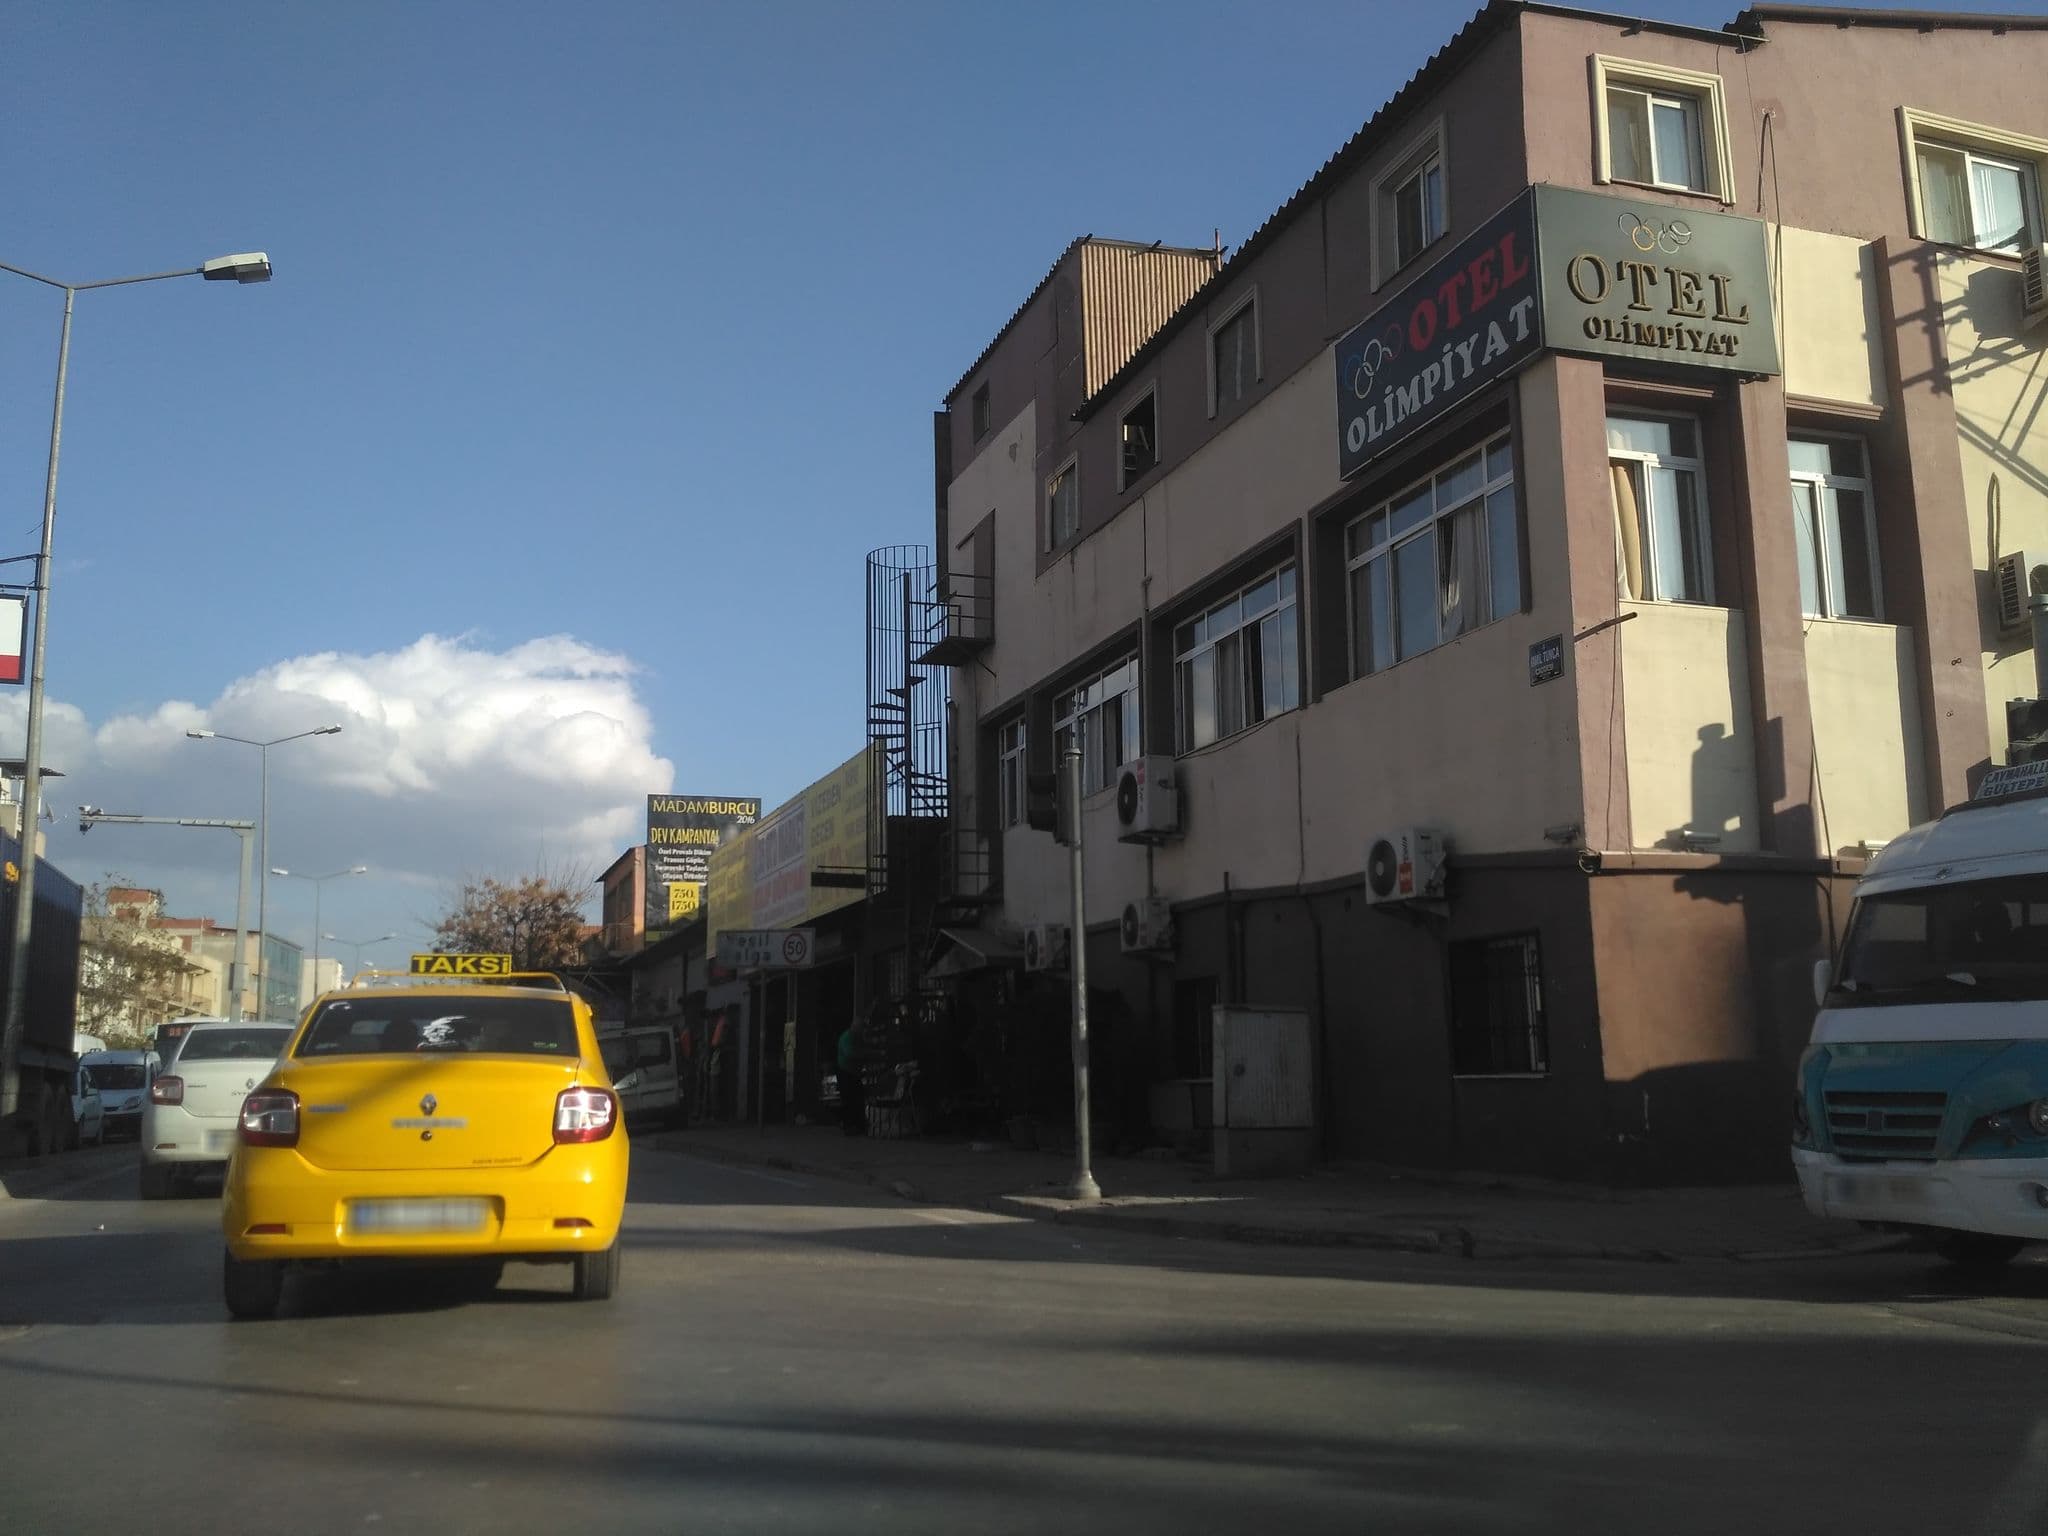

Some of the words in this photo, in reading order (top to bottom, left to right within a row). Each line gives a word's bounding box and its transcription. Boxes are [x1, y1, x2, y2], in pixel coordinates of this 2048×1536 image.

[1408, 231, 1530, 352] OTEL
[1566, 252, 1750, 325] OTEL
[1582, 313, 1739, 357] OLİMPİYAT
[1345, 294, 1535, 454] OLİMPİYAT
[652, 799, 756, 816] MADAMBURCU
[736, 815, 756, 825] 2016
[650, 827, 668, 844] DEV
[671, 900, 696, 911] 1750
[786, 940, 804, 956] 50
